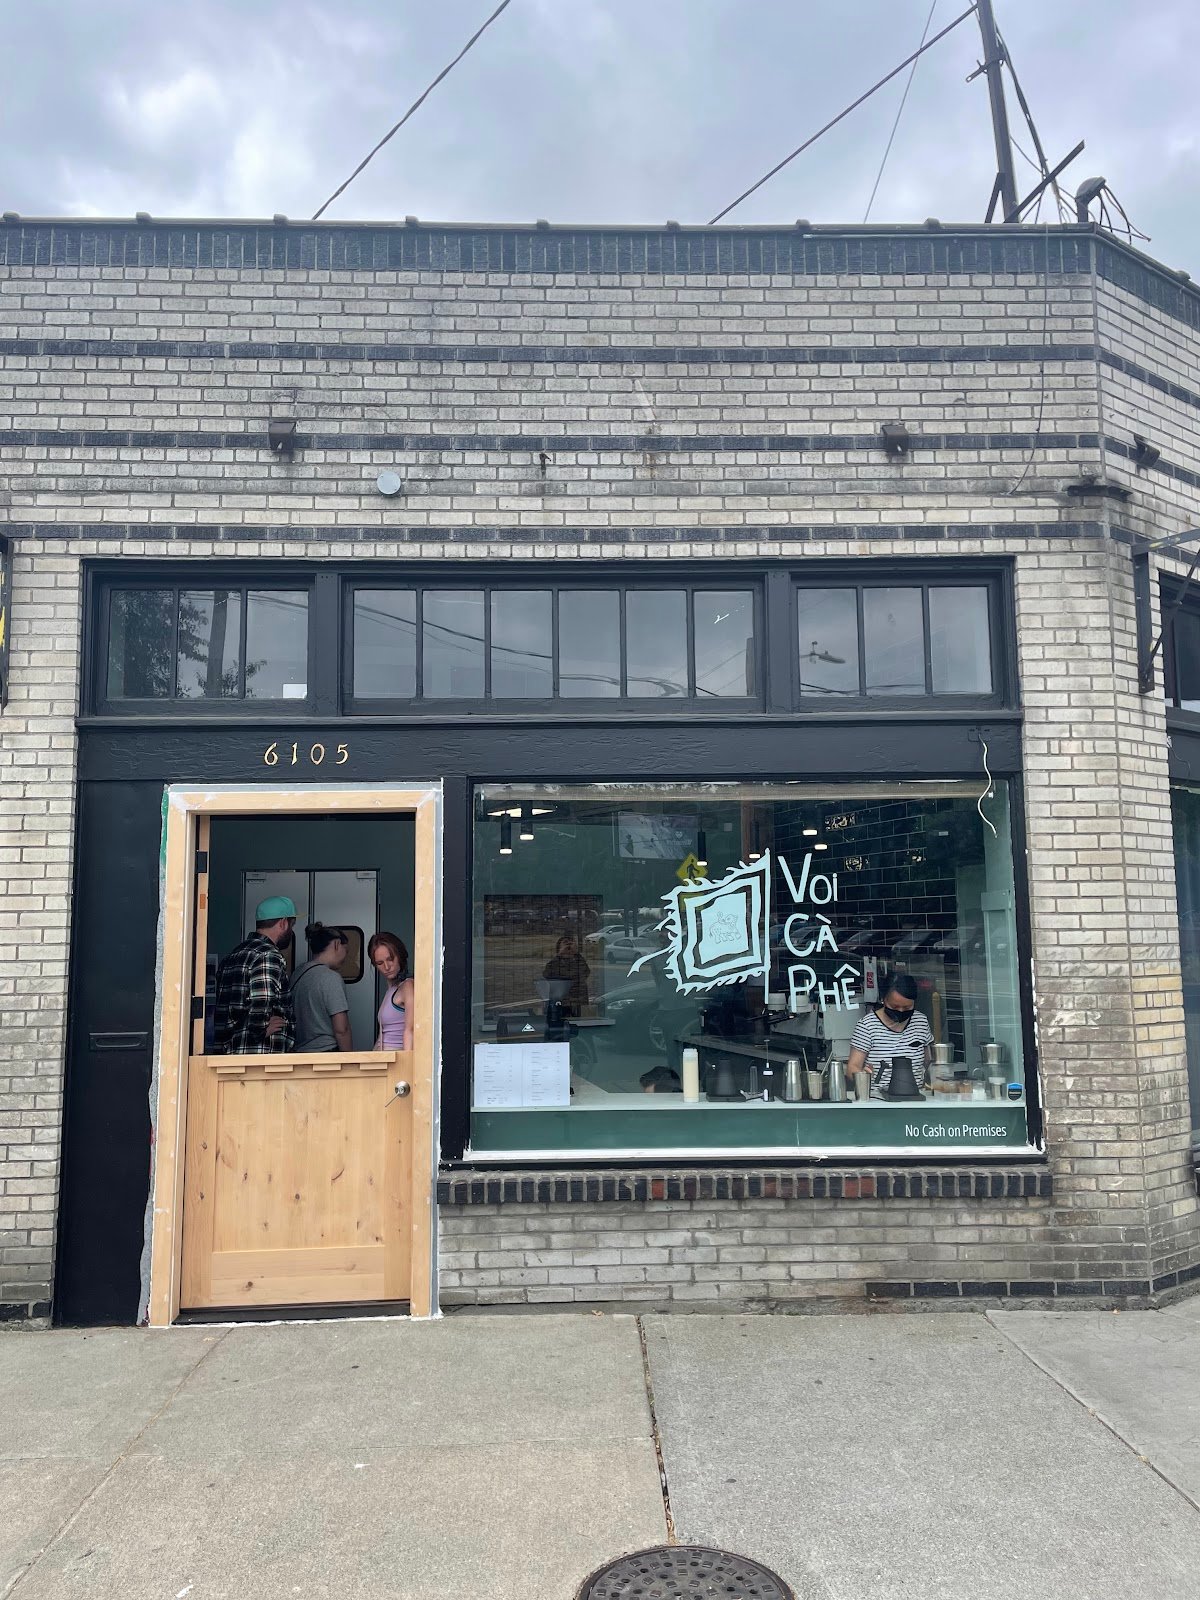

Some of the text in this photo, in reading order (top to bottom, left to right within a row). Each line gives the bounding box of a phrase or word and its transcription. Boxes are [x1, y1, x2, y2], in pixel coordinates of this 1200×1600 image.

[264, 742, 349, 766] 6105
[777, 852, 839, 905] Voi
[784, 912, 840, 958] CÀ
[787, 963, 861, 1013] PHÊ
[905, 1124, 1007, 1137] No Cash on Premises
